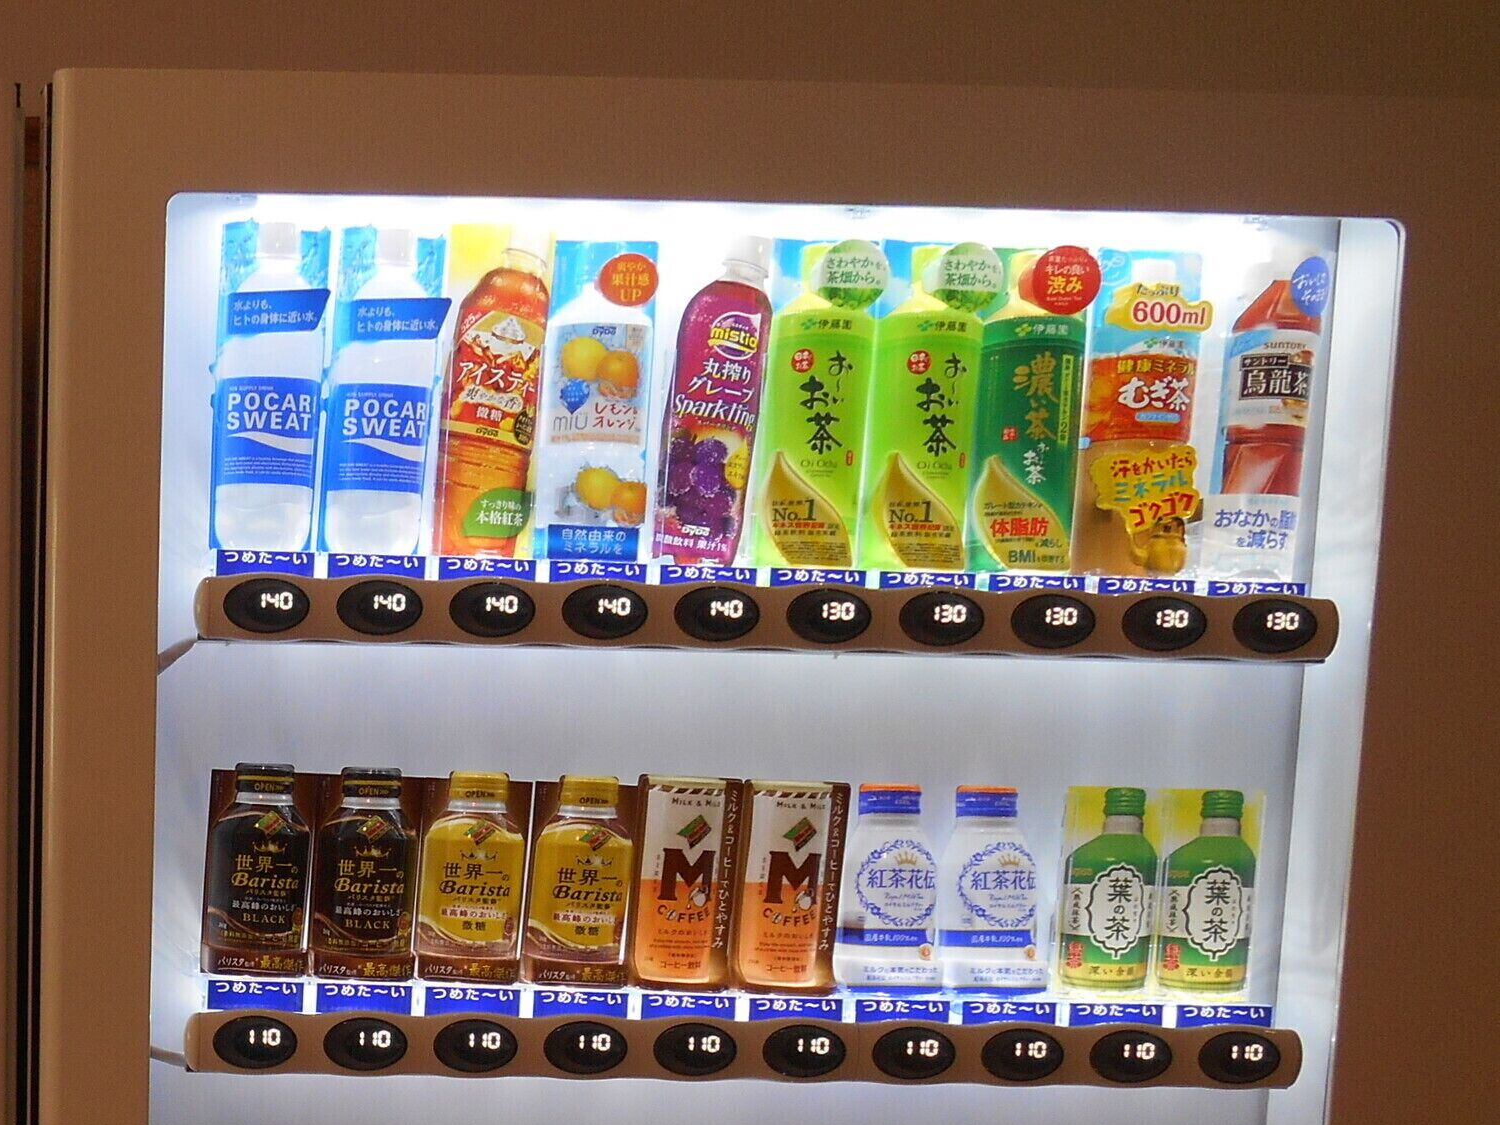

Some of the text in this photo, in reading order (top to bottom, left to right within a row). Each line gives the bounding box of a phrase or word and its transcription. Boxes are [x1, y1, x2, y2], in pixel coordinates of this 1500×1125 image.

[612, 274, 650, 287] 果汁感
[1048, 276, 1083, 295] 渋み
[620, 288, 642, 302] UP
[1133, 301, 1205, 325] 600ml
[818, 320, 852, 330] 伊藤園
[1264, 341, 1306, 350] SUNTORY
[701, 358, 751, 385] 丸搾り
[1242, 357, 1287, 367] サントリー
[457, 362, 536, 396] アイスティー
[1118, 376, 1191, 411] むぎ茶
[227, 412, 312, 432] SWEAT
[476, 406, 502, 422] 微糖
[592, 415, 636, 430] オレンジ
[674, 394, 756, 432] Sparkling
[800, 375, 843, 455] お茶
[1110, 452, 1193, 478] 汗をかいたら
[476, 509, 523, 527] 本格紅茶
[773, 499, 817, 522] No.1
[1129, 491, 1196, 527] ゴクゴク
[562, 529, 626, 542] 自然由来の
[990, 517, 1049, 537] 体脂肪
[564, 542, 622, 556] ミネラルを
[1008, 550, 1036, 563] BMI
[260, 591, 294, 611] 140
[485, 594, 519, 614] 140
[821, 601, 856, 621] 130
[1045, 606, 1078, 626] 130
[1155, 608, 1190, 629] 130
[254, 783, 275, 792] OPEN
[235, 855, 298, 874] 世界一の
[443, 863, 510, 881] 世界一の
[231, 871, 299, 890] Barista
[657, 848, 716, 901] M
[867, 869, 936, 890] 紅茶花伝
[439, 880, 510, 898] Barista
[552, 885, 623, 903] Barista
[243, 913, 286, 924] BLACK
[657, 904, 710, 923] COFFEE
[1105, 877, 1132, 941] 葉の茶
[462, 920, 486, 932] 微糖
[249, 1027, 281, 1047] 110
[578, 1033, 611, 1052] 110
[797, 1036, 830, 1055] 110
[1015, 1040, 1047, 1059] 110
[1231, 1043, 1264, 1062] 110
